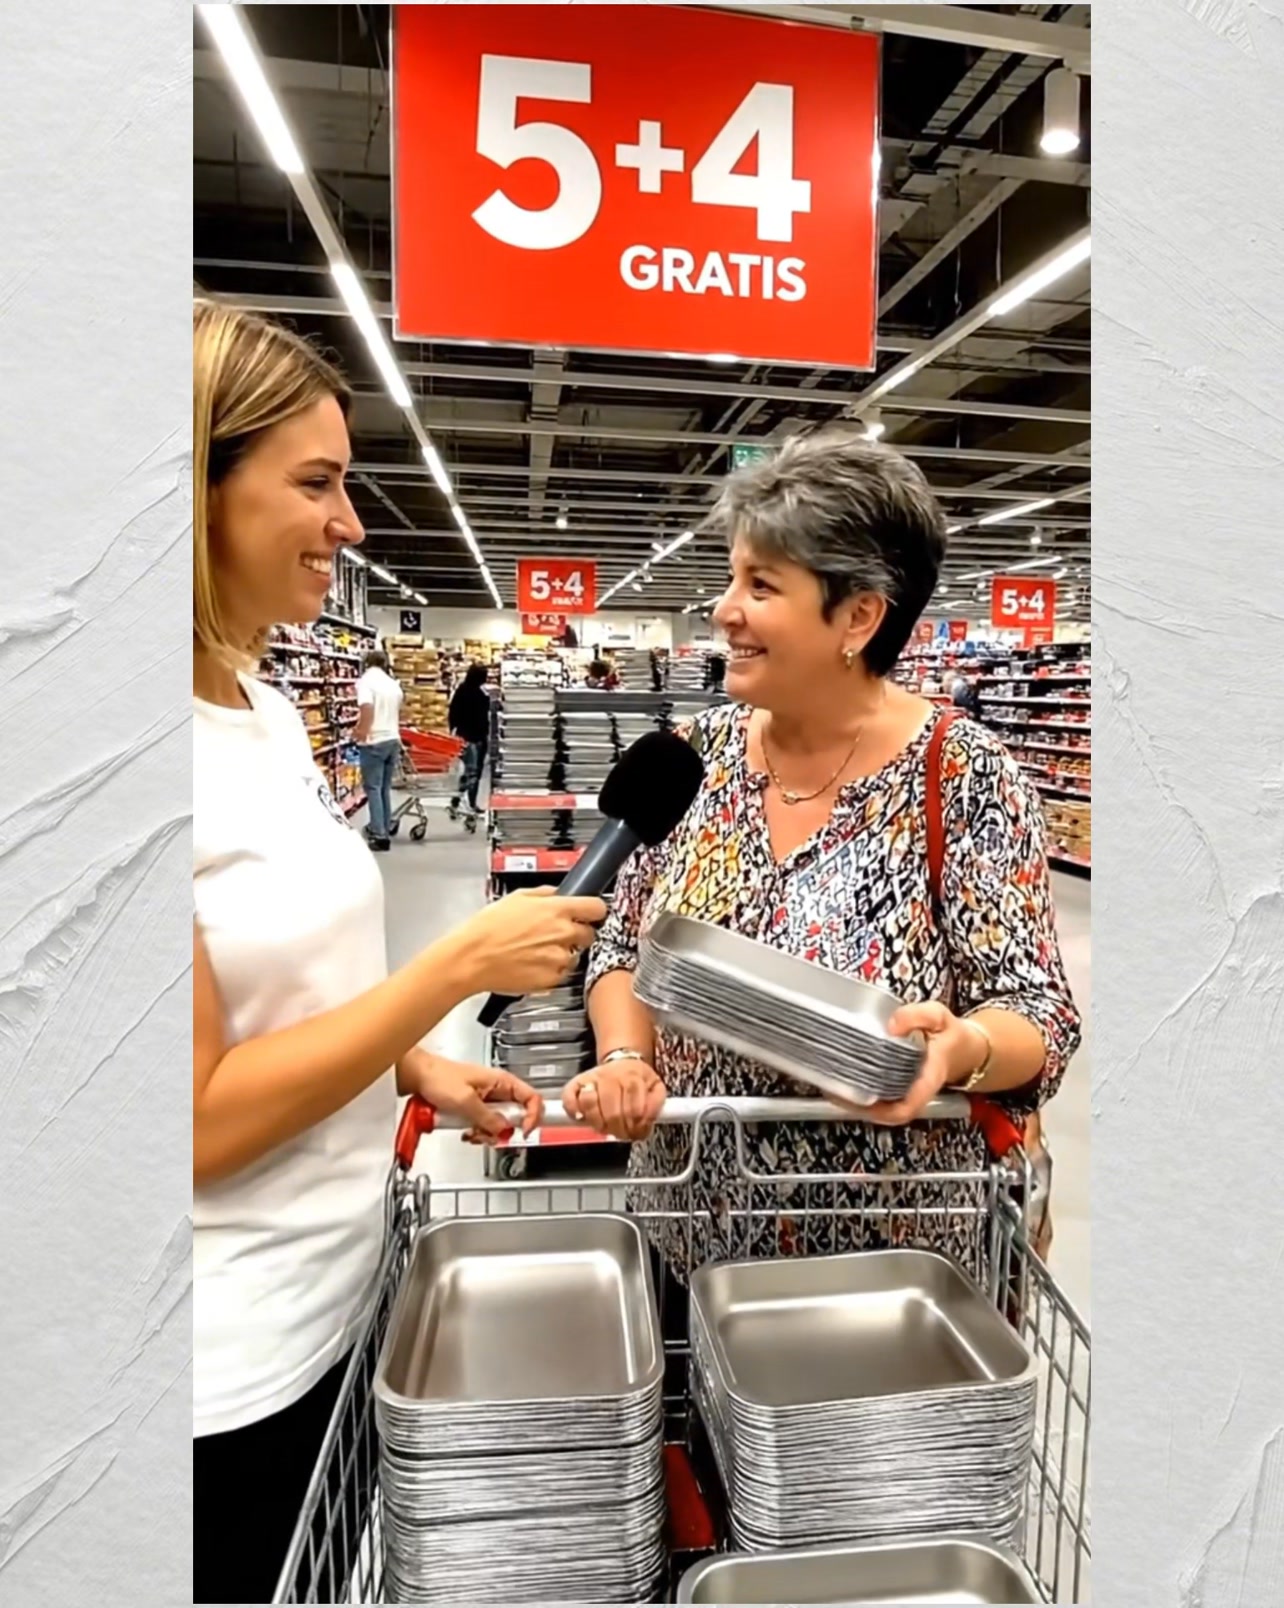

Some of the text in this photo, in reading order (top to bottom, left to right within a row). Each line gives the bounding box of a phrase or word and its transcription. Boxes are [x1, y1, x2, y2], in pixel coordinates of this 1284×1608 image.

[471, 53, 811, 250] 5+4
[619, 245, 807, 302] GRATIS
[530, 570, 584, 600] 5+4
[1001, 589, 1045, 615] 5+4
